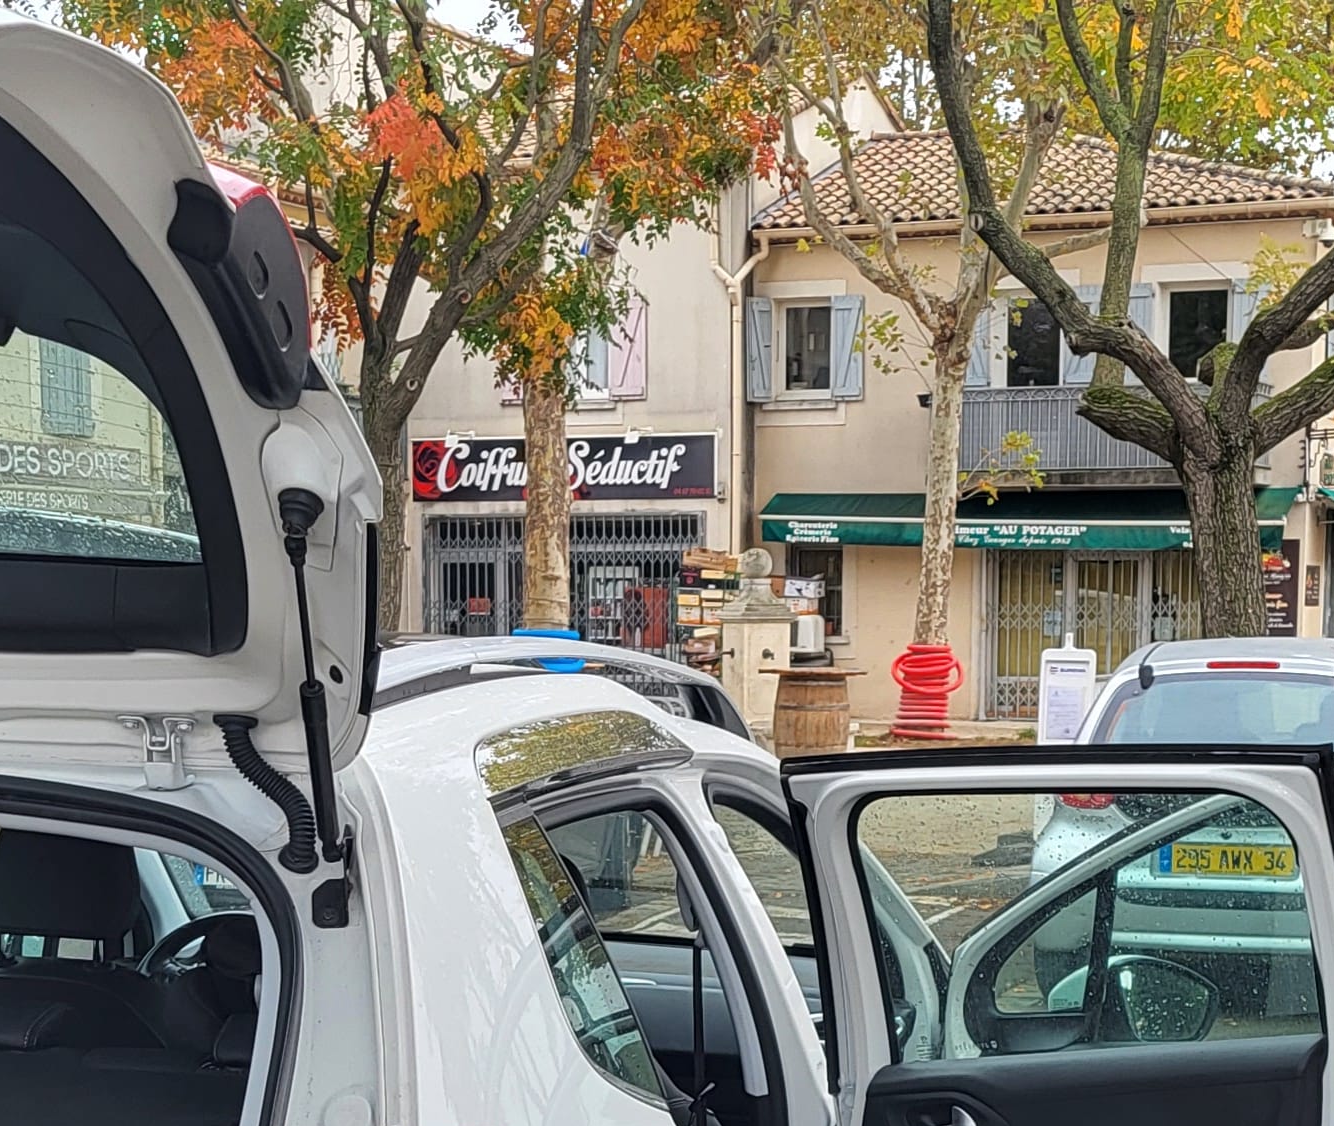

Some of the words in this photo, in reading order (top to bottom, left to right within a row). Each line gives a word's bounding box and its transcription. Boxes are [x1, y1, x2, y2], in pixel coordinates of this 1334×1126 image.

[47, 448, 131, 480] SPORTS
[436, 442, 527, 492] Coiffu
[568, 440, 685, 491] Séductif
[27, 491, 47, 508] DES
[49, 492, 89, 511] SPORTS
[954, 525, 989, 534] imeur
[1218, 849, 1254, 870] AWX
[1264, 851, 1287, 871] 34
